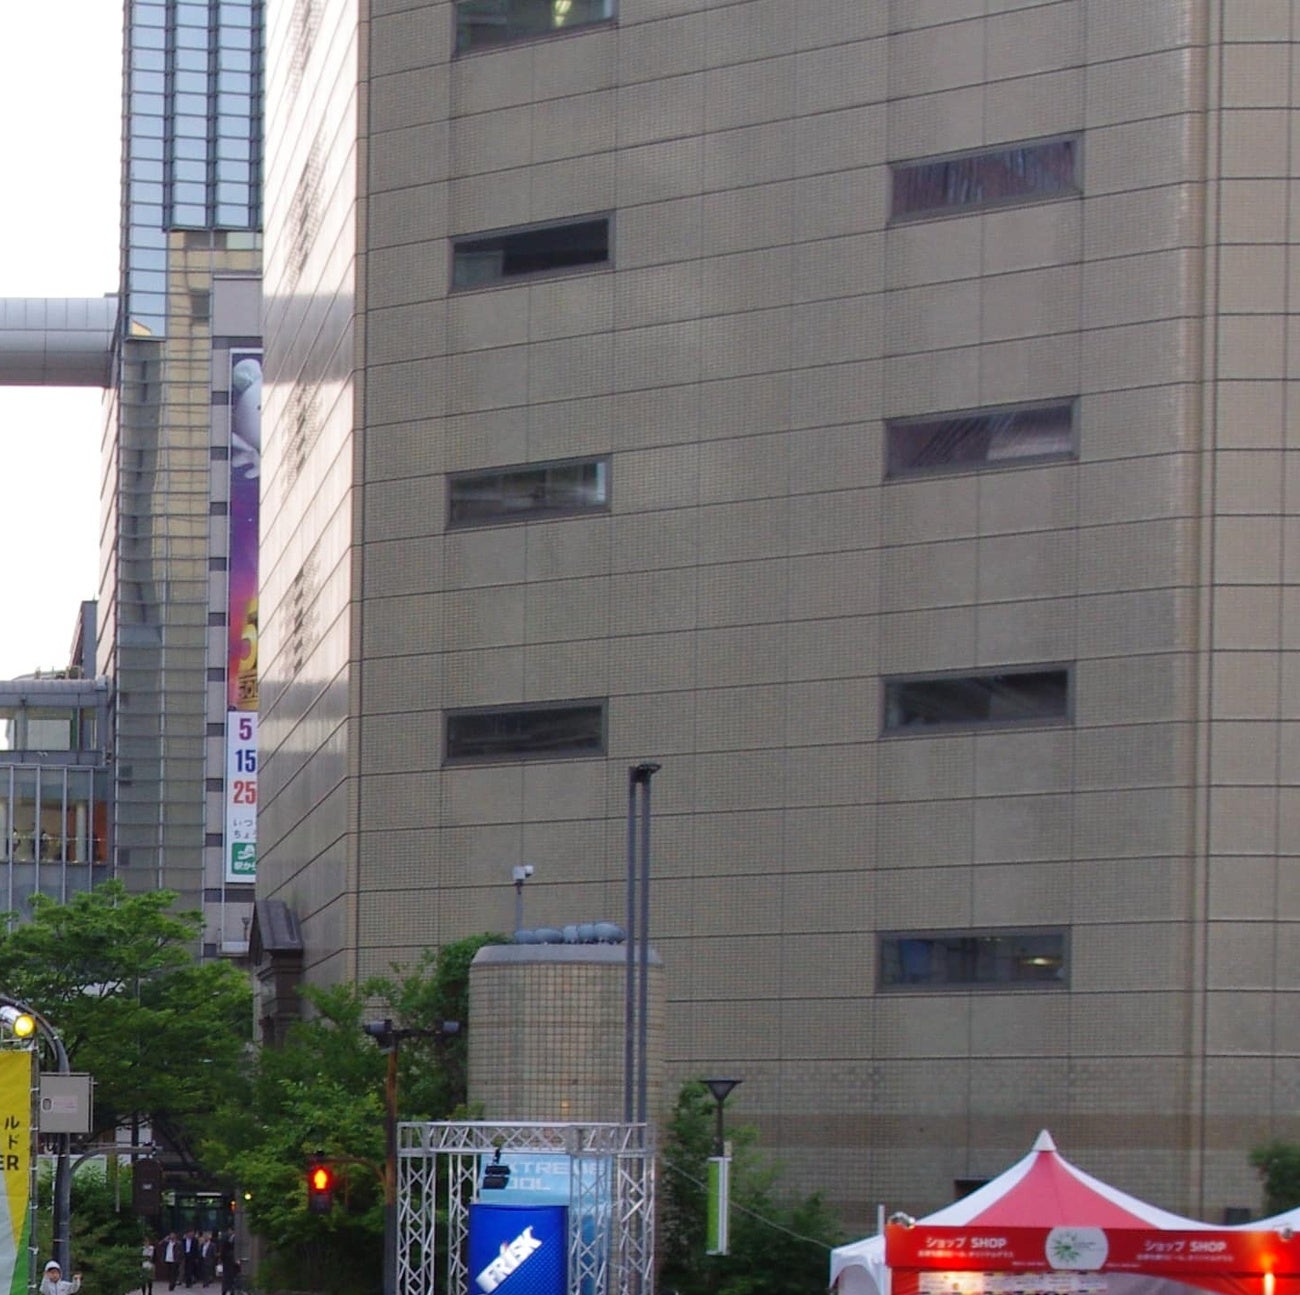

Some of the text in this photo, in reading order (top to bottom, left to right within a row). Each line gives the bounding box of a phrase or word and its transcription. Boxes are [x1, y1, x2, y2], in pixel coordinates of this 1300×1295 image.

[239, 718, 252, 740] 5
[235, 749, 256, 772] 15
[233, 781, 257, 804] 25
[926, 1237, 1007, 1248] ショップ SHOP
[475, 1225, 542, 1293] FRISK
